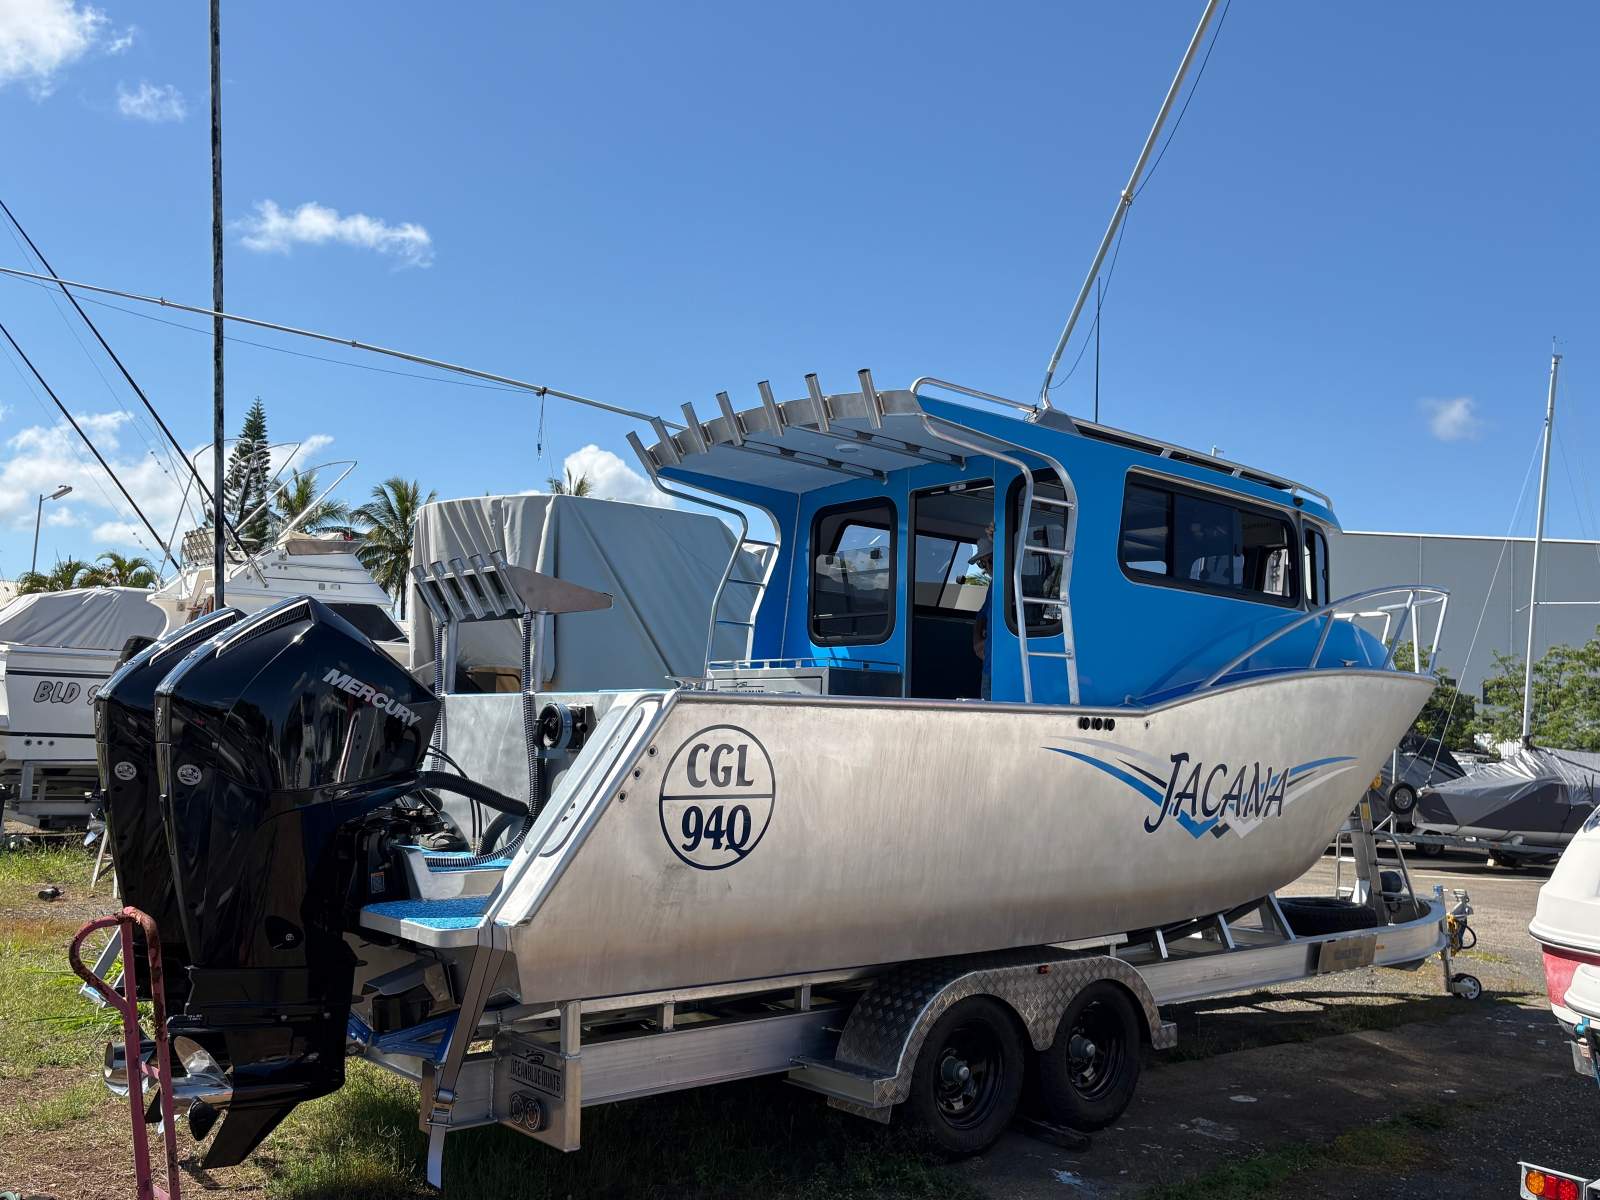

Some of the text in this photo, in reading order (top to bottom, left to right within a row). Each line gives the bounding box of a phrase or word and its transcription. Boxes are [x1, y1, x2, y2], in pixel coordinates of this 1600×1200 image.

[33, 681, 81, 704] BLD
[322, 668, 421, 727] MERCURY
[687, 743, 754, 787] CGL
[1144, 752, 1289, 833] JACANA
[682, 804, 752, 859] 94Q
